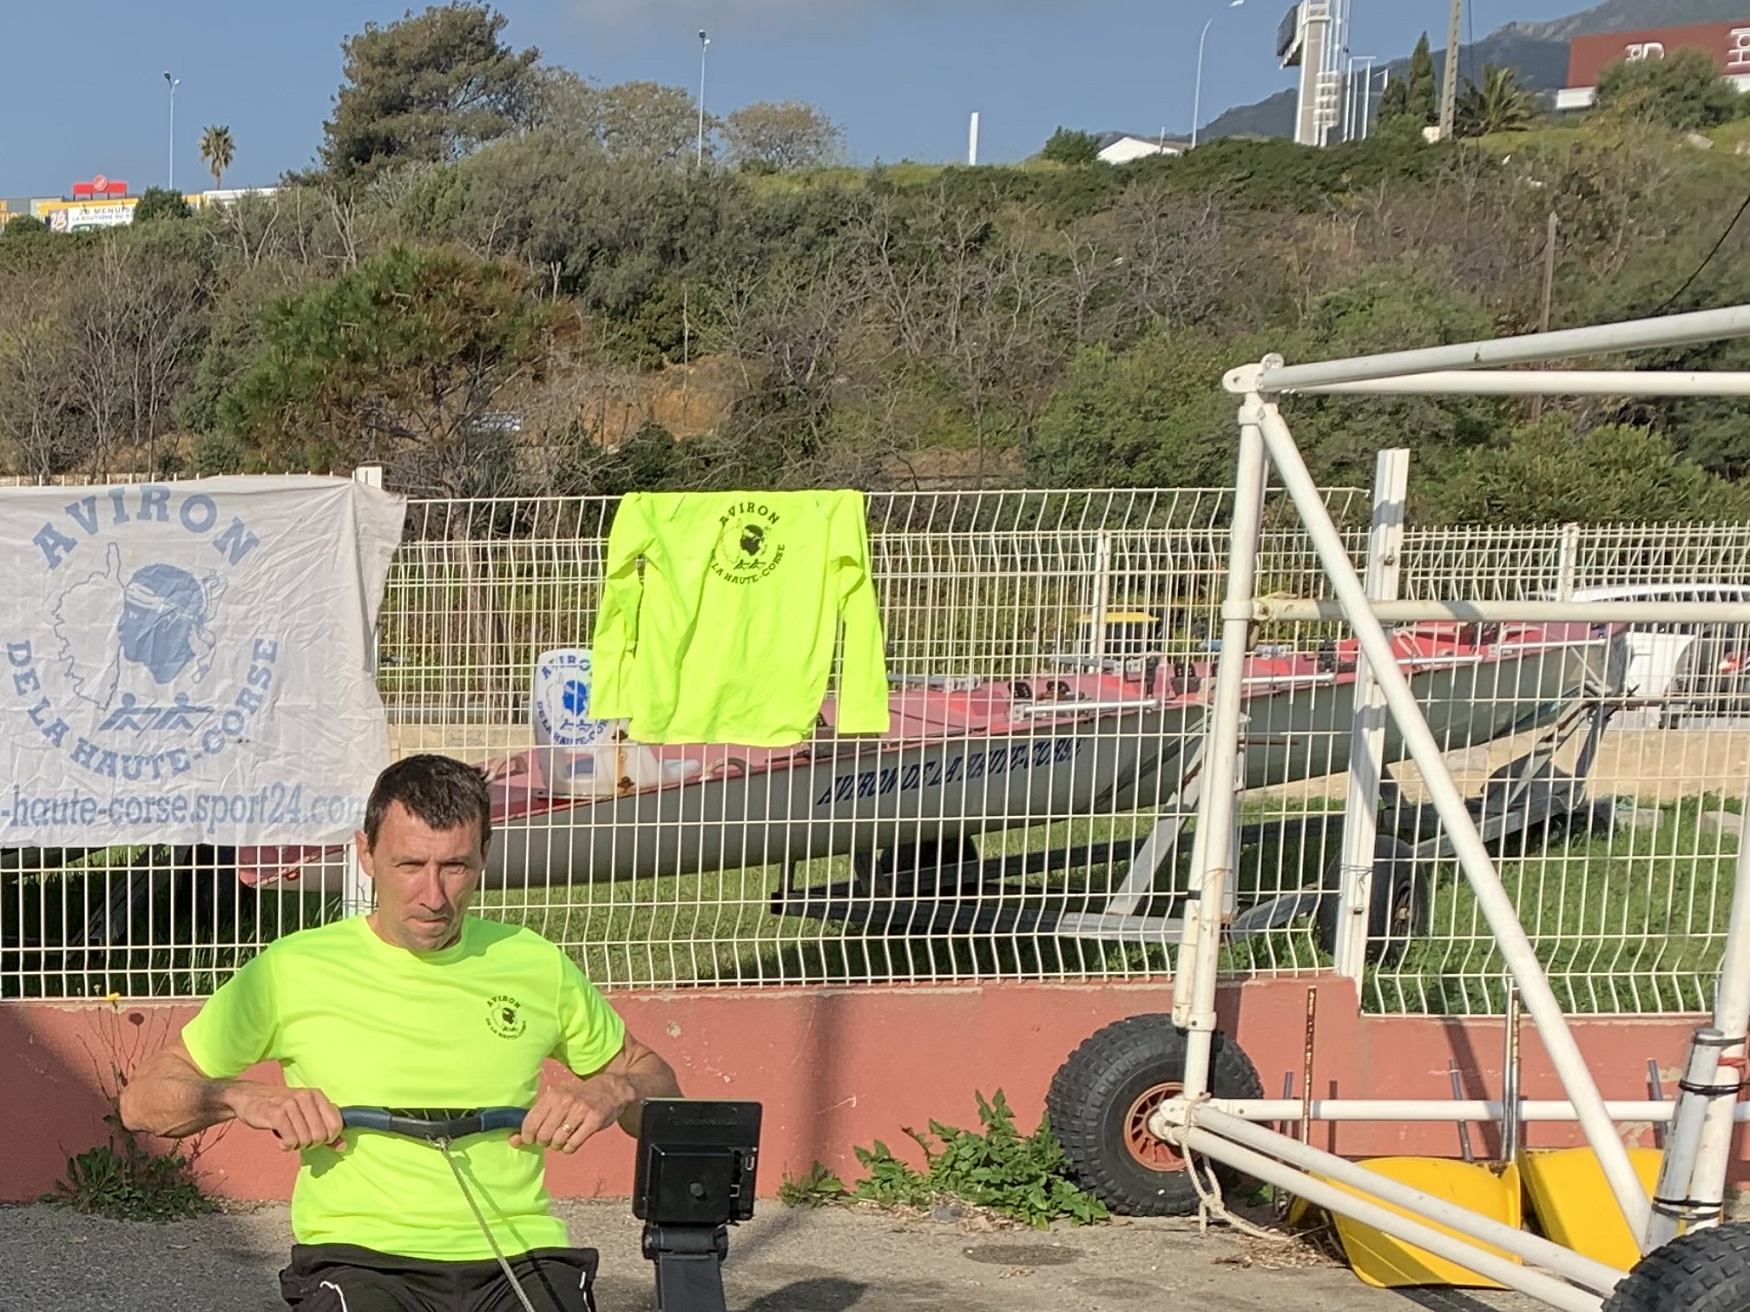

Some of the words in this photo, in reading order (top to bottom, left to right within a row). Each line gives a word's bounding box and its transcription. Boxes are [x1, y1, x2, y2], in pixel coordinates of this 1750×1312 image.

[32, 485, 260, 571] AVIRON
[719, 501, 780, 525] AVIRON
[6, 640, 41, 696] DE
[27, 696, 70, 748] LA
[69, 638, 278, 781] HAUTE-CORSE
